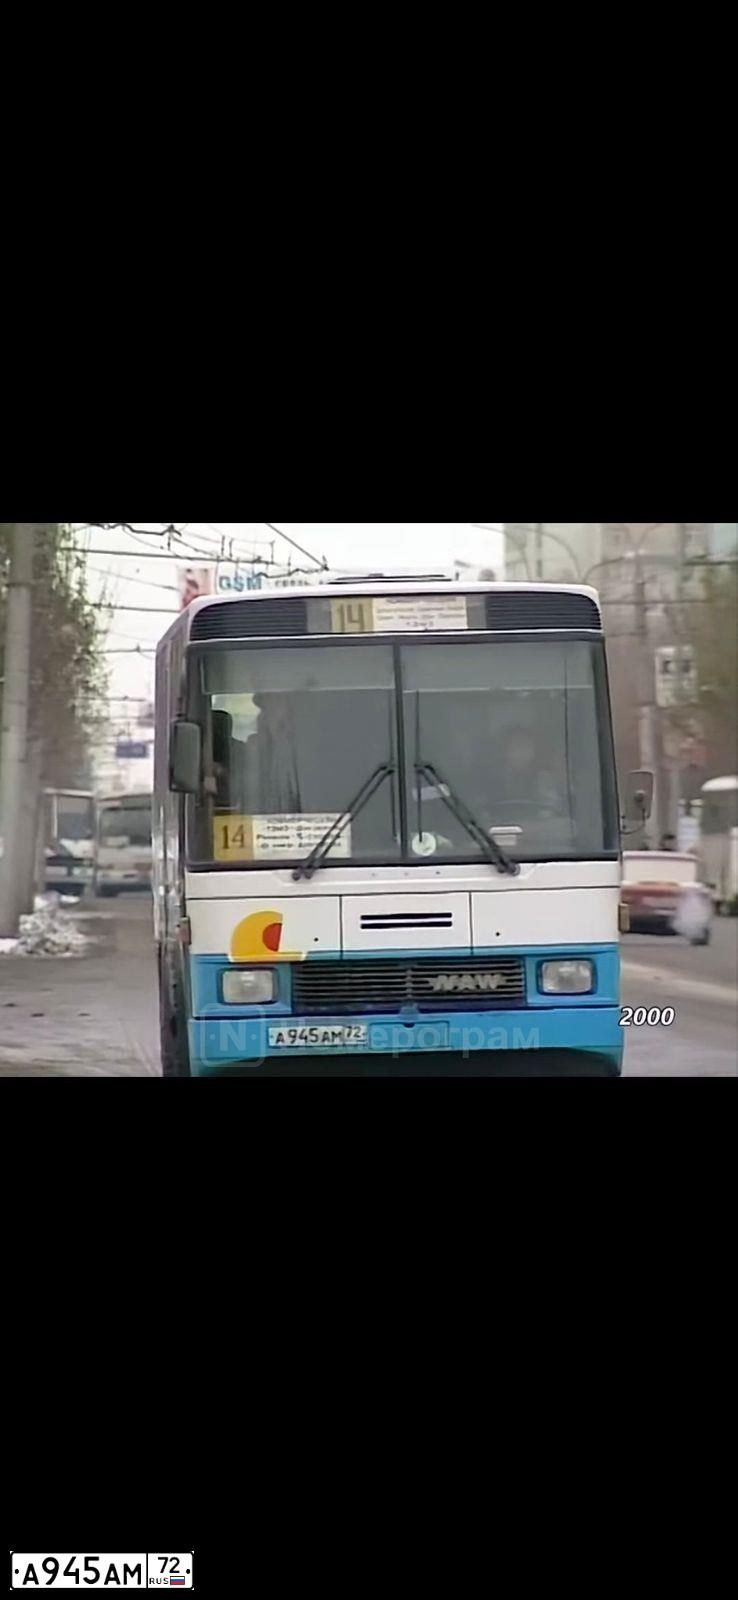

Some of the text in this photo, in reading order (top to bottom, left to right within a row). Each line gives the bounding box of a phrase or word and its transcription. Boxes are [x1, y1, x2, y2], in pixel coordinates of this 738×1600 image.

[218, 576, 262, 591] GSM
[337, 604, 365, 631] 14
[221, 823, 245, 849] 14
